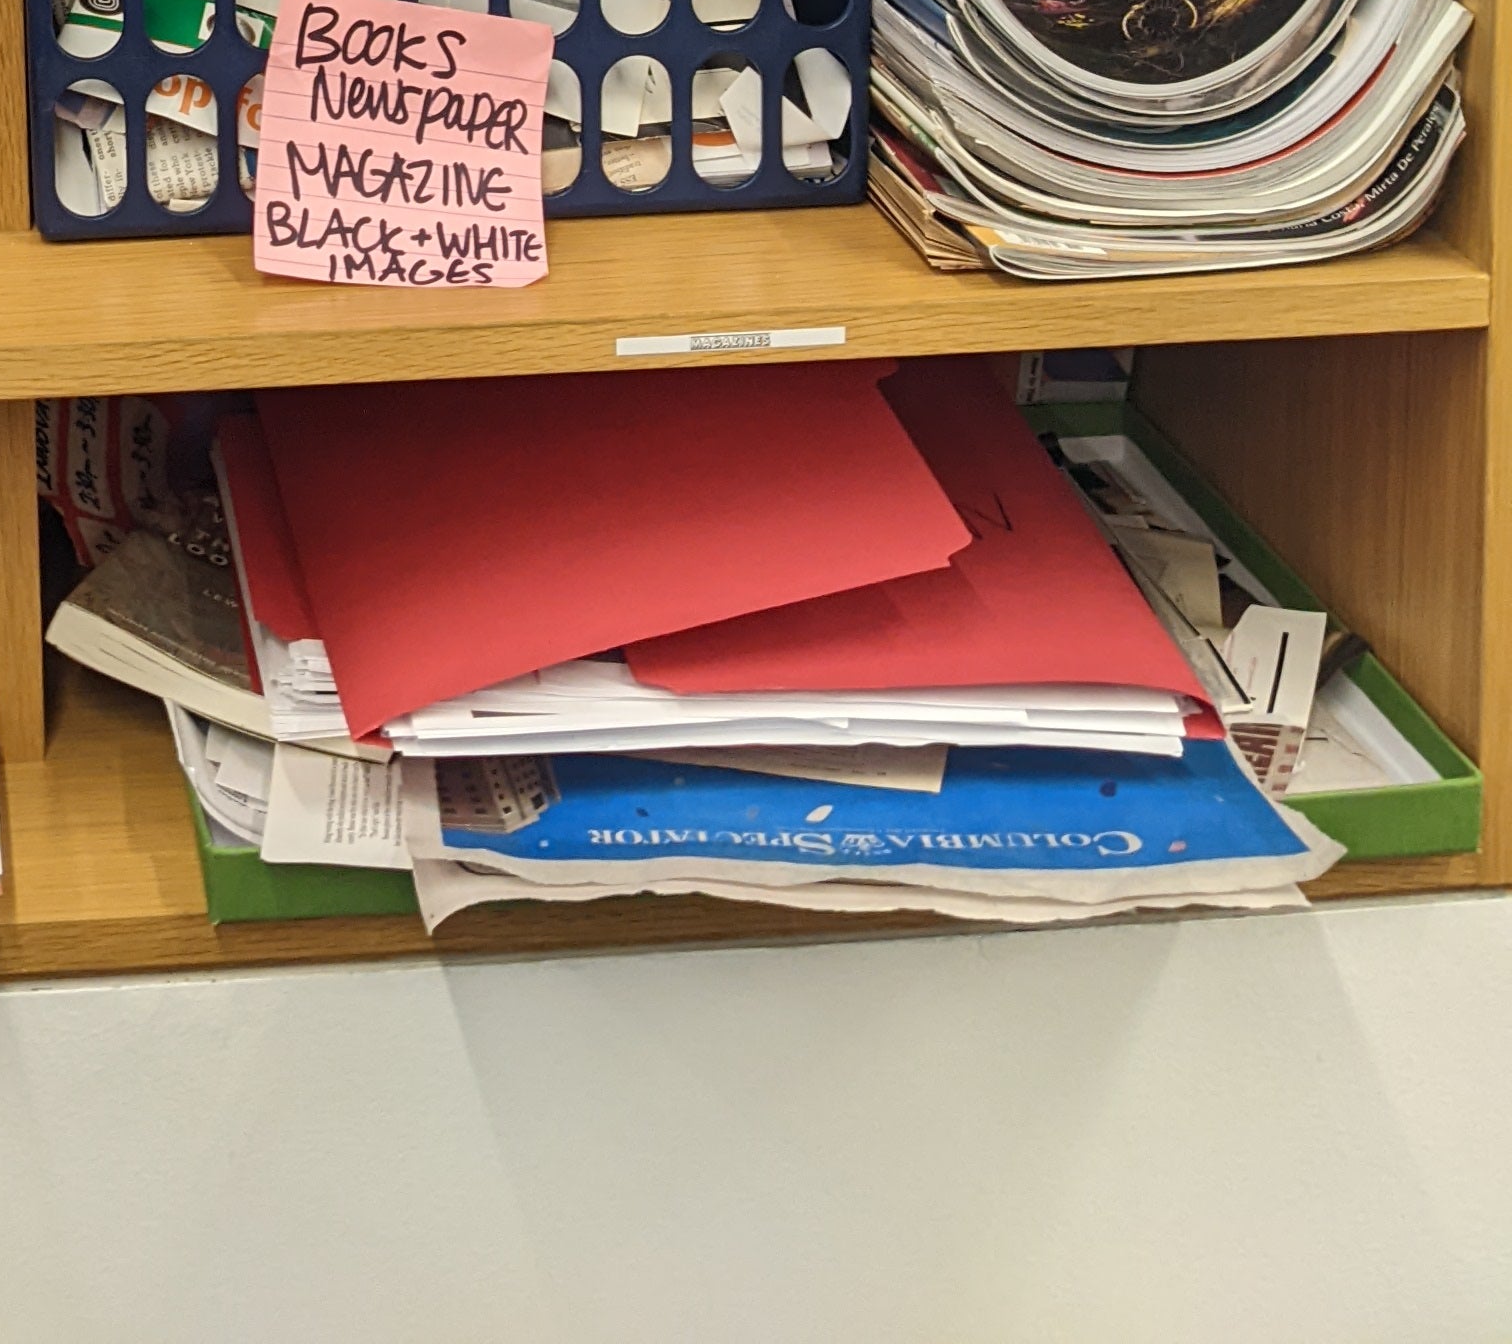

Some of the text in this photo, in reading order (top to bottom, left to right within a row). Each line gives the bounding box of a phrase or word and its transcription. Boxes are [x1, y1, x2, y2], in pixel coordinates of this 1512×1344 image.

[295, 2, 467, 79] BOOKS
[286, 140, 513, 211] MAGAZINE
[1365, 171, 1399, 202] Mirta
[1396, 152, 1414, 172] De
[1411, 104, 1442, 152] Perales
[266, 200, 406, 256] BLACK
[437, 221, 543, 262] WHITE
[328, 249, 494, 285] IMAGES
[887, 829, 1145, 857] COLUMBIA
